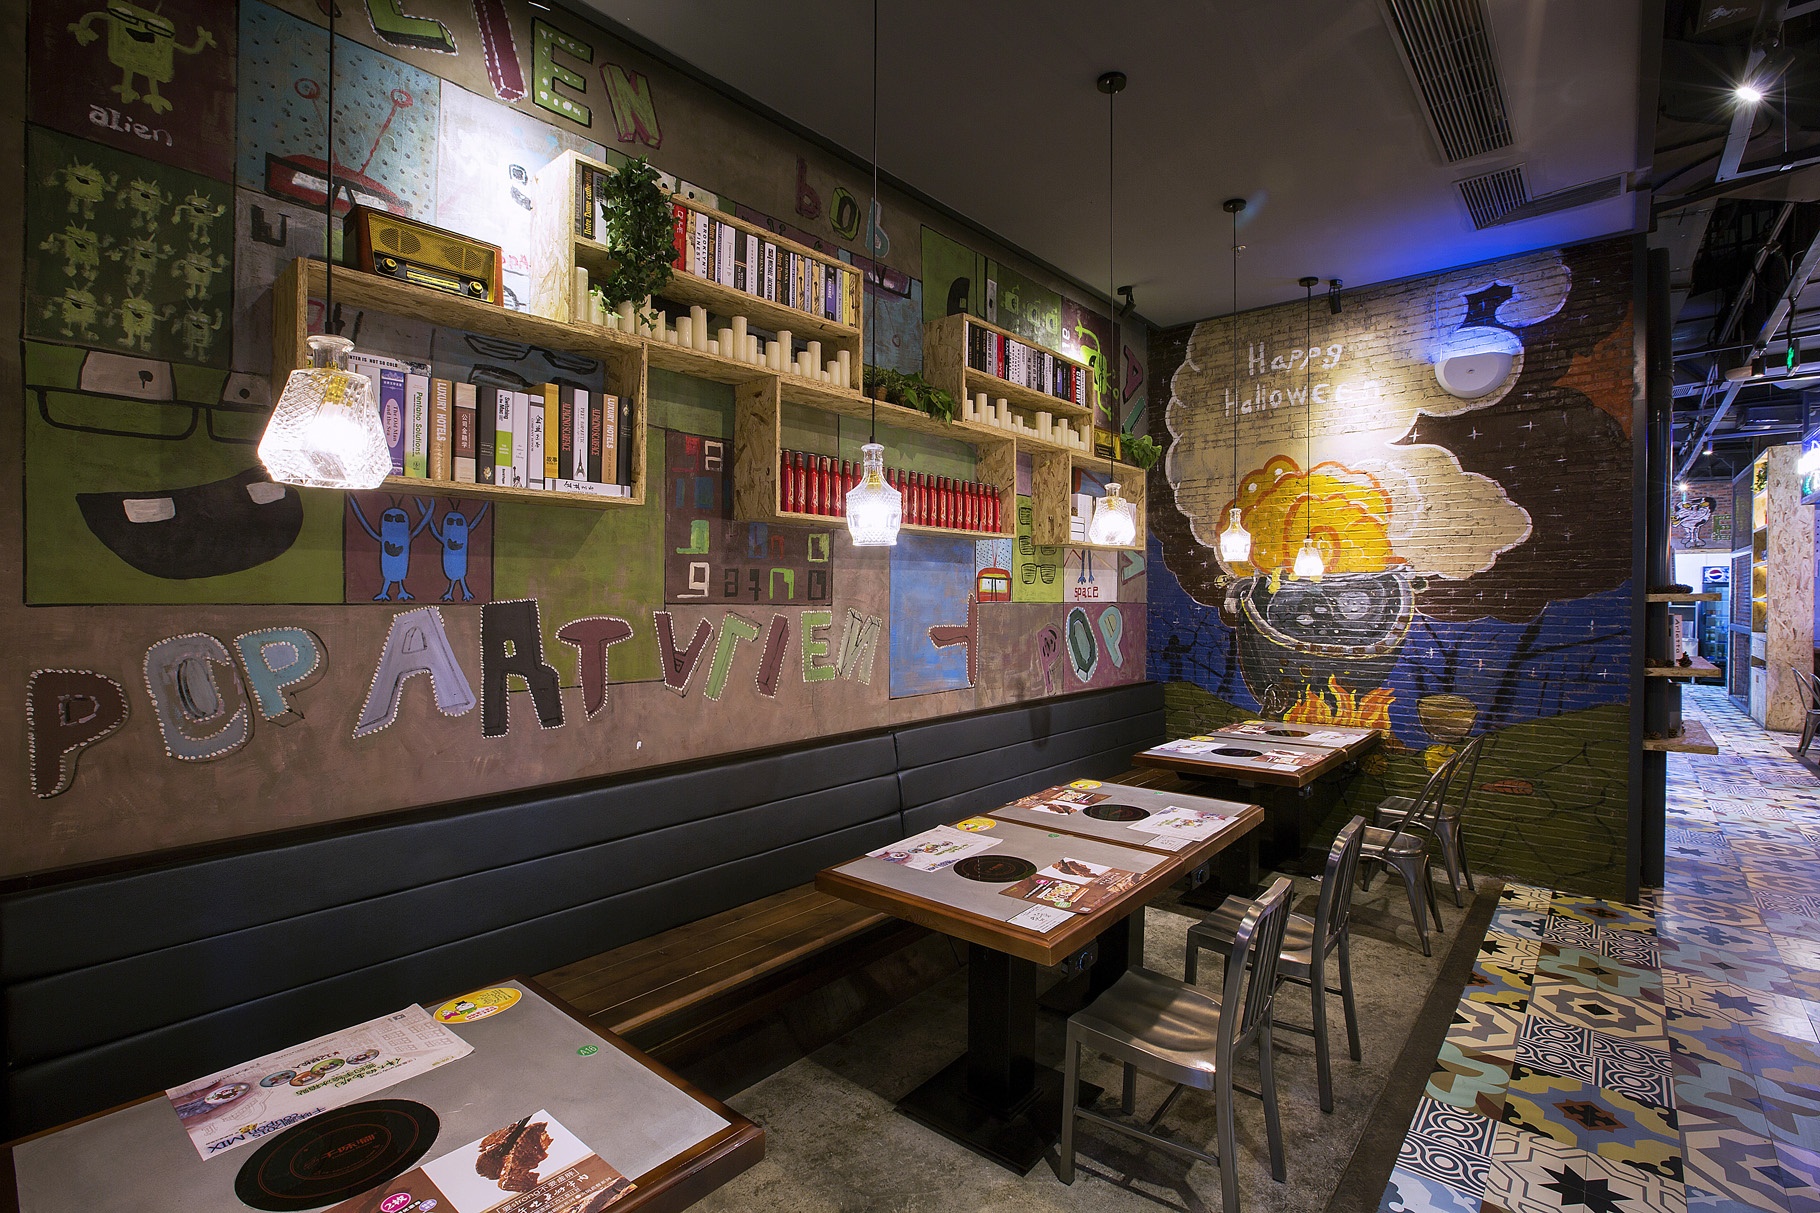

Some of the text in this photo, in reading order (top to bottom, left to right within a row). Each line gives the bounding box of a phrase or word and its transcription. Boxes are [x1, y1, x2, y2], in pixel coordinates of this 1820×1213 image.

[312, 0, 662, 149] LIEN
[89, 103, 173, 147] alien
[436, 382, 447, 412] LUXURY
[503, 396, 511, 420] Switching
[607, 397, 615, 423] LUXURY
[414, 391, 423, 456] Pentaho Solutions
[437, 413, 447, 442] HOTELS
[606, 424, 615, 449] HOTELS
[1074, 586, 1099, 601] space
[26, 626, 328, 798] POP
[352, 598, 635, 738] ART
[1037, 604, 1124, 696] POP
[580, 1045, 598, 1057] A16
[248, 1112, 299, 1135] coupon
[207, 1134, 246, 1154] MIX
